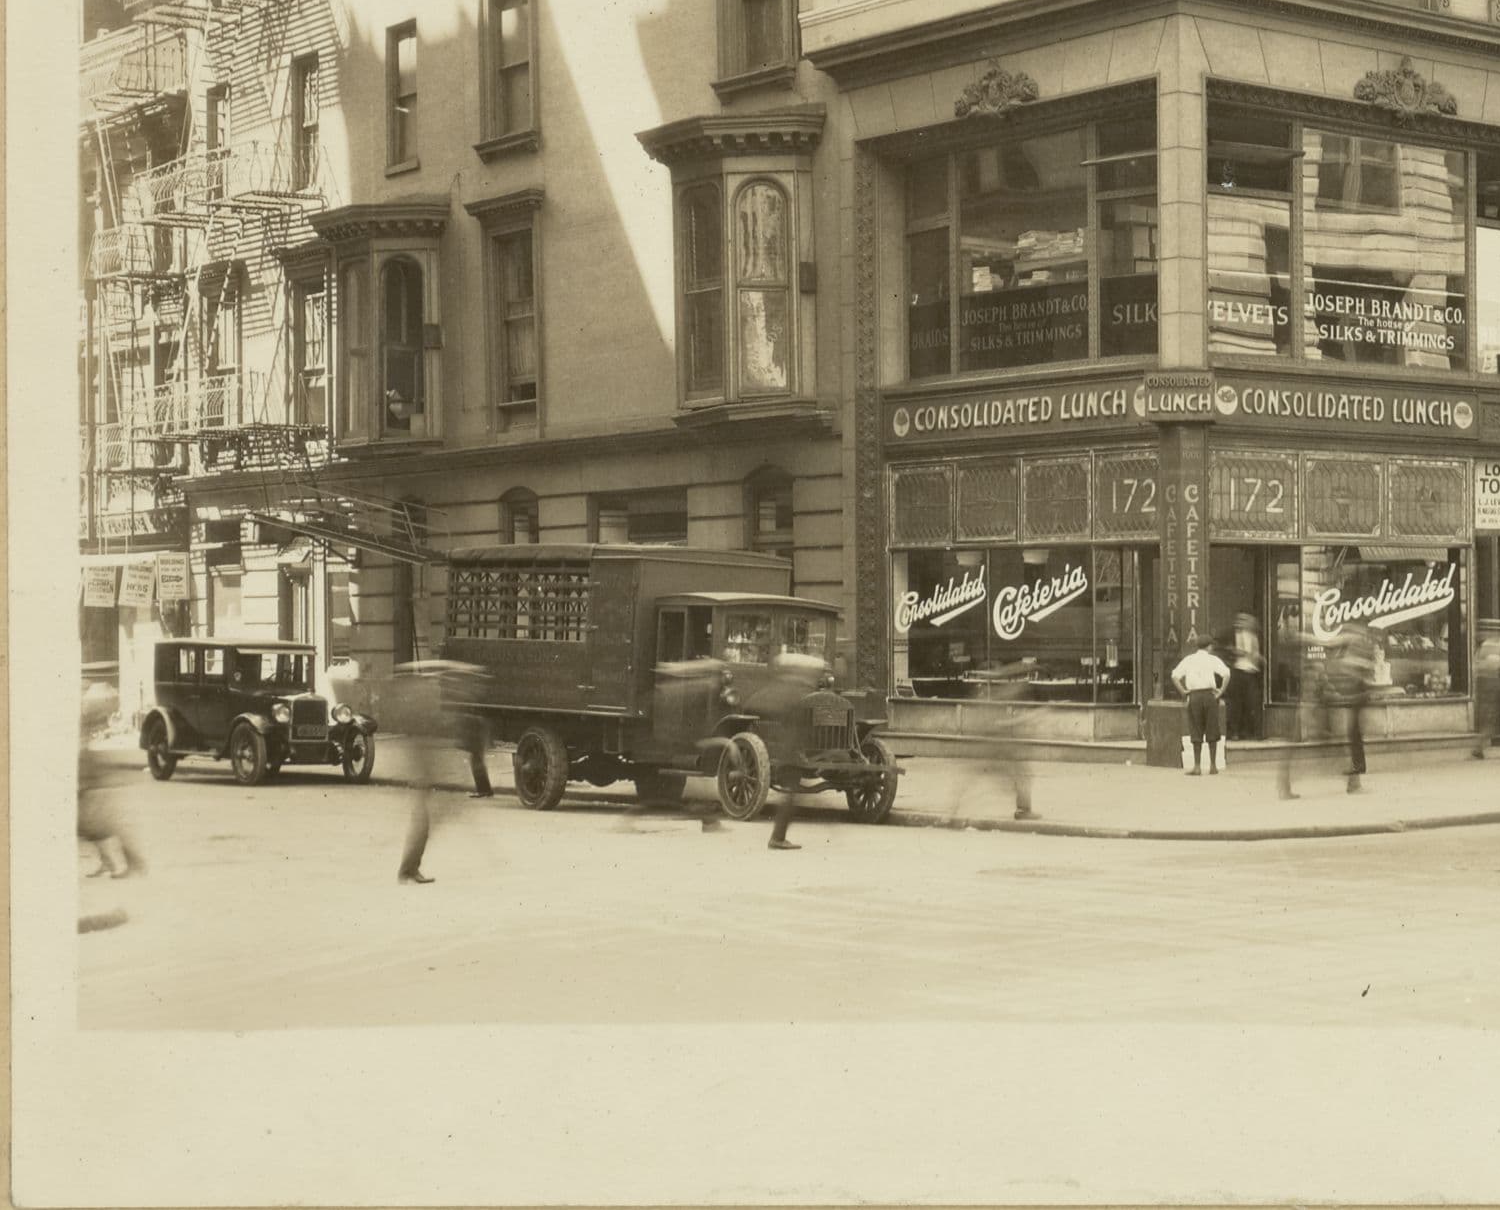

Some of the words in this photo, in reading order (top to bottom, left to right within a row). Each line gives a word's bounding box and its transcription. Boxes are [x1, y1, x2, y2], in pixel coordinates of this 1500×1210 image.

[961, 302, 1008, 327] JOSEPH
[1010, 296, 1061, 321] BRANDT
[1308, 293, 1365, 315] JOSEPH
[1371, 298, 1434, 322] BRANDT
[1357, 315, 1374, 328] The
[1376, 316, 1402, 330] house
[970, 331, 1004, 351] SILKS
[1015, 323, 1083, 346] TRIMMINGS
[1318, 323, 1364, 343] SILKS
[1365, 328, 1376, 343] &
[1378, 328, 1456, 351] TRIMMINGS
[1146, 375, 1212, 389] CONSOLIDATED
[914, 395, 1052, 432] CONSOLIDATED
[1060, 389, 1127, 420] LUNCH
[1147, 392, 1212, 414] LUNCH
[1241, 390, 1385, 422] CONSOLIDATED
[1393, 394, 1453, 426] LUNCH
[1111, 478, 1158, 513] 172
[1229, 478, 1285, 514] 172
[1479, 477, 1500, 495] TO
[1164, 482, 1179, 644] CAFETERIA
[1183, 483, 1201, 645] CAFETERIA
[894, 564, 987, 634] Consolidated
[993, 563, 1088, 641] Cafeteria
[1311, 562, 1456, 641] Consolidated
